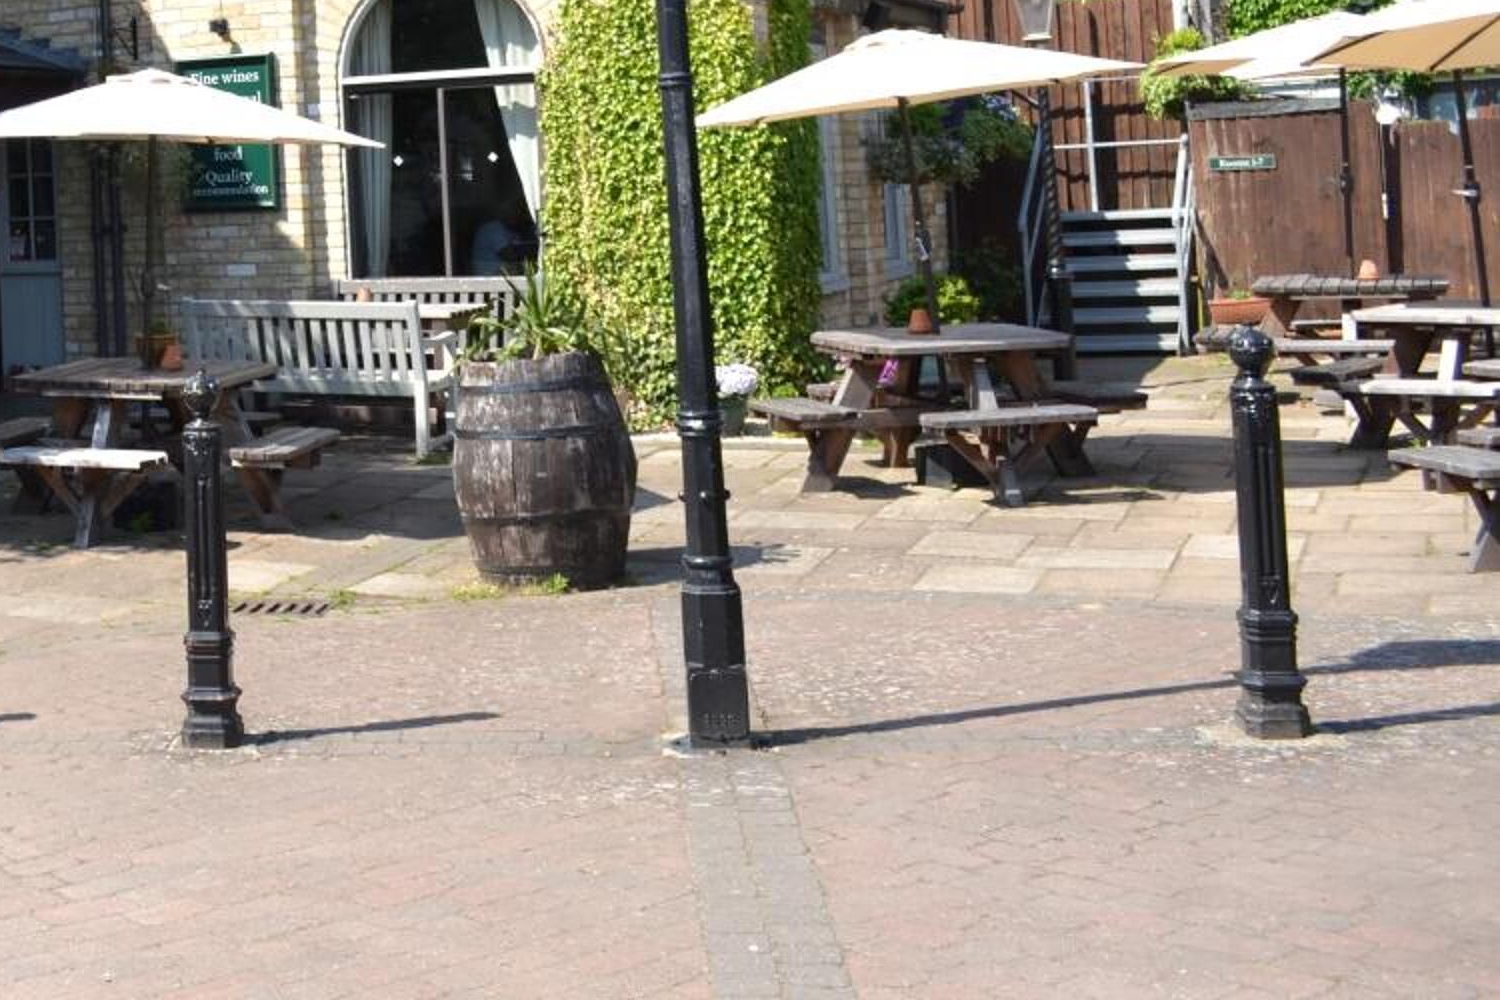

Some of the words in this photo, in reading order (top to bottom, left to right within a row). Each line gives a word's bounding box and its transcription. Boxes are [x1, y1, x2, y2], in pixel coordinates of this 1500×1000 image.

[221, 68, 259, 84] wines
[214, 145, 243, 161] food
[204, 168, 253, 187] Quality
